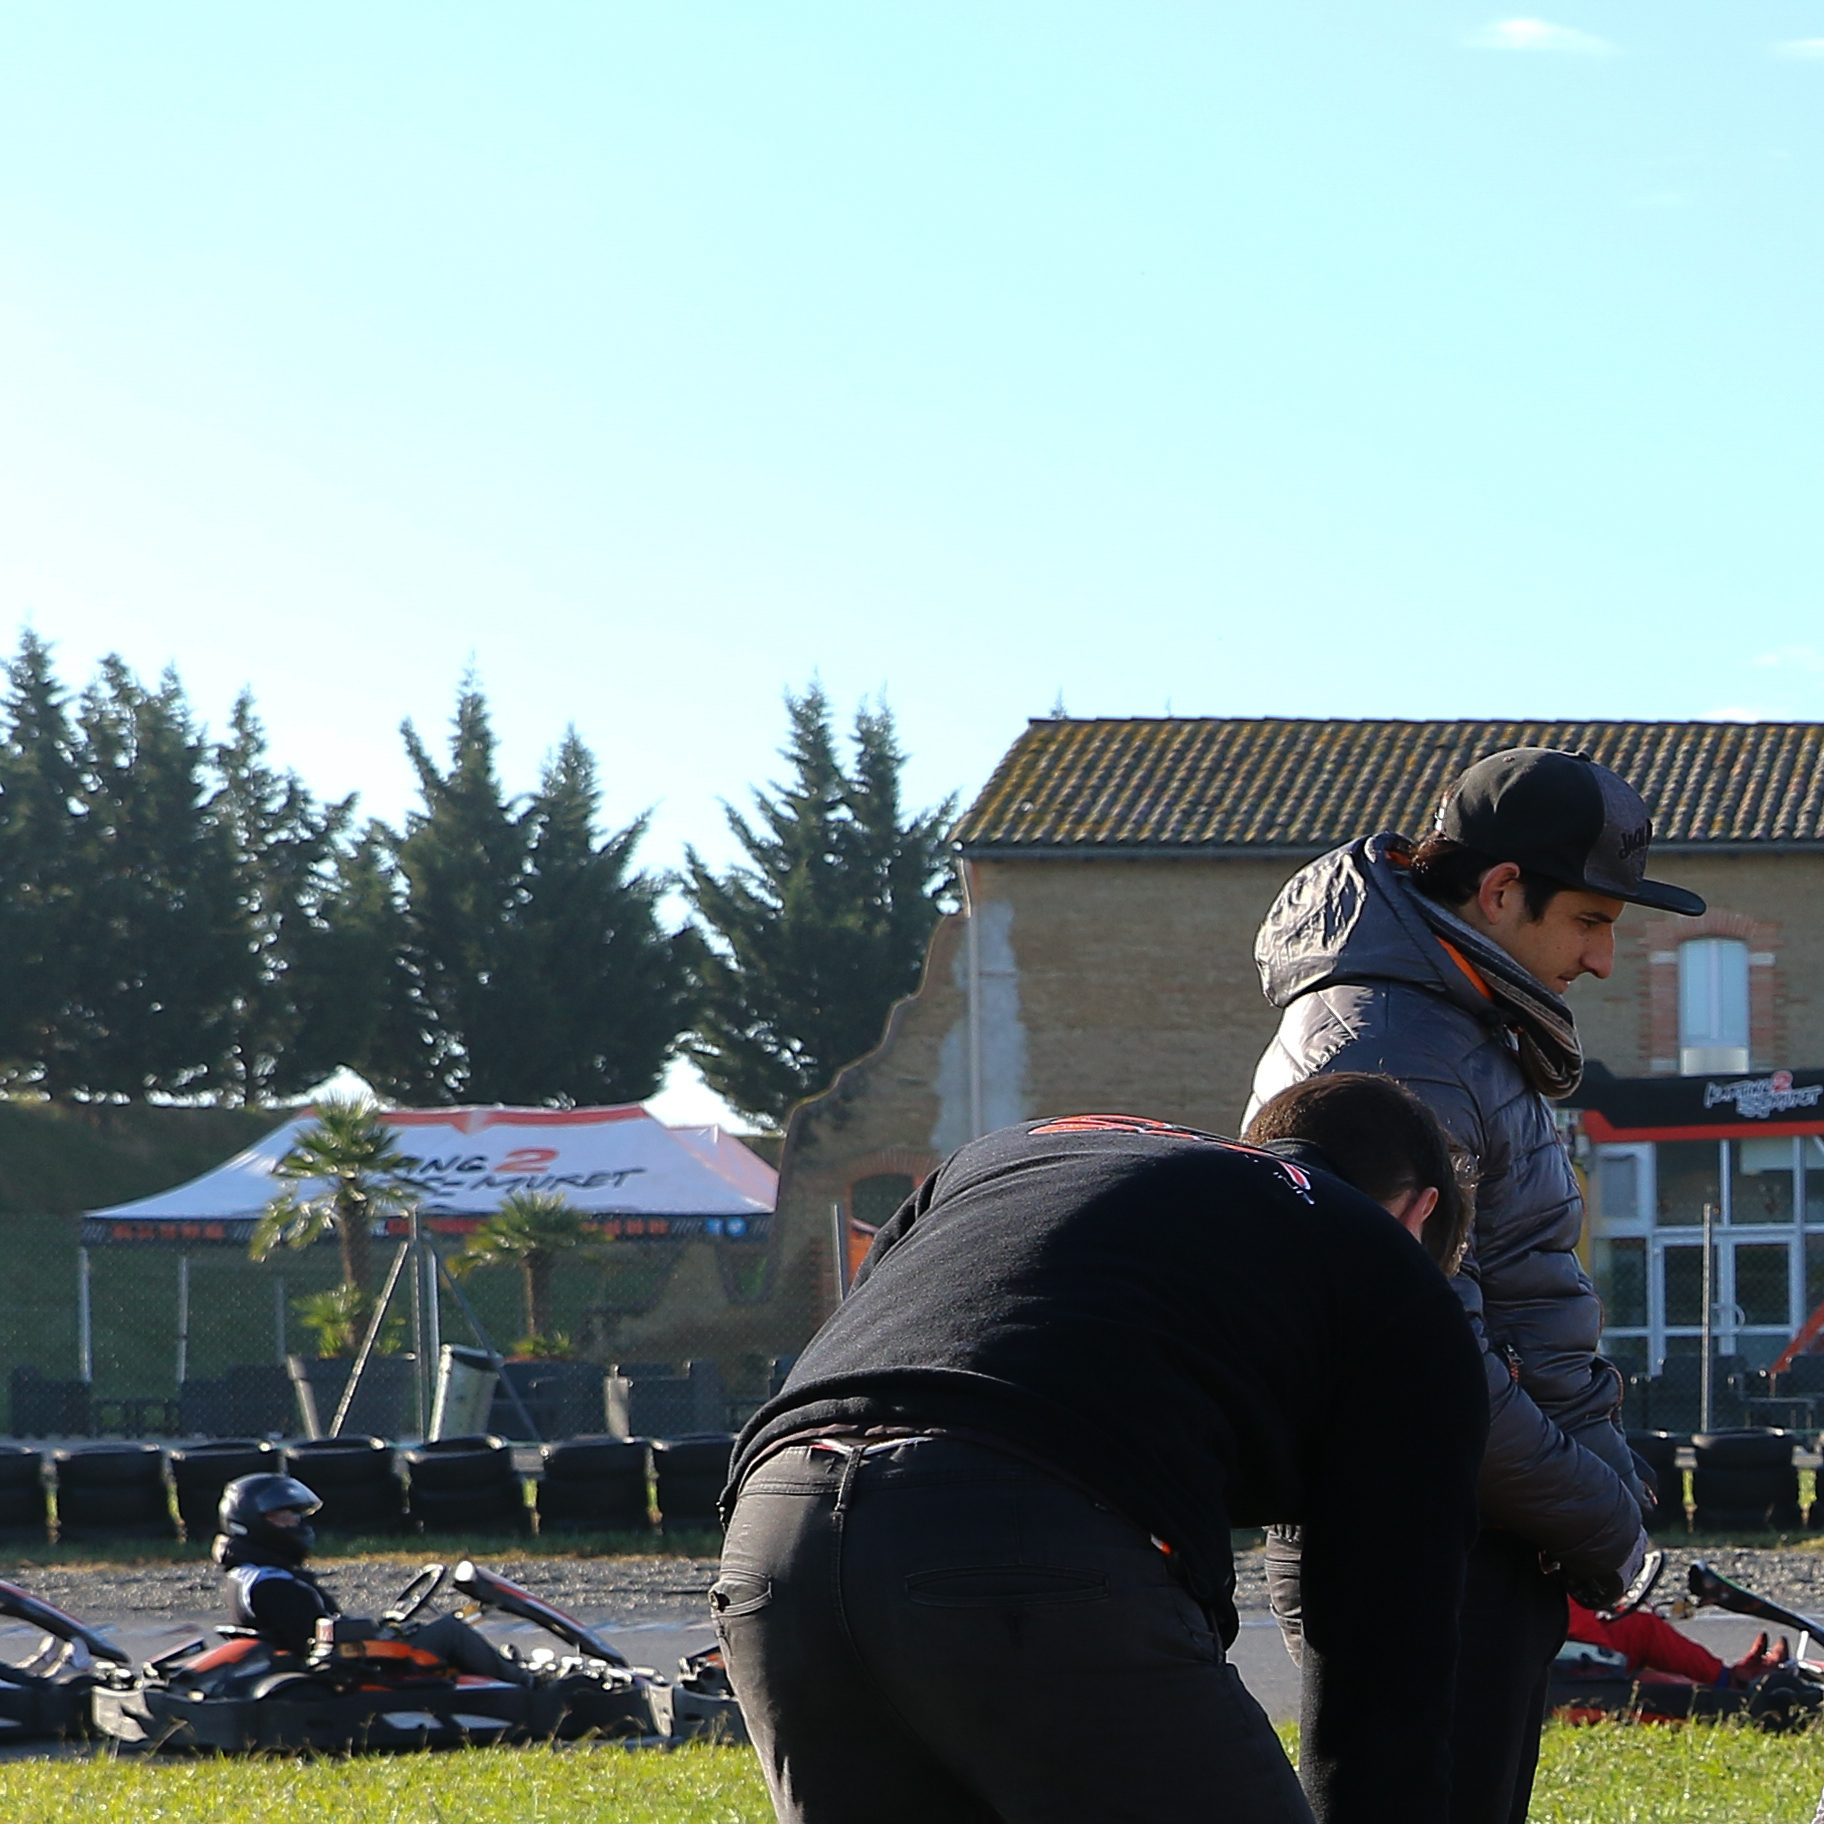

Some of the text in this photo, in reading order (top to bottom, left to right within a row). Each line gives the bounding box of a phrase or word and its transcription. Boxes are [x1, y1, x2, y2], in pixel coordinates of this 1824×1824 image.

[1770, 1070, 1794, 1093] 2
[495, 1147, 559, 1172] 2
[474, 1167, 647, 1194] MURET
